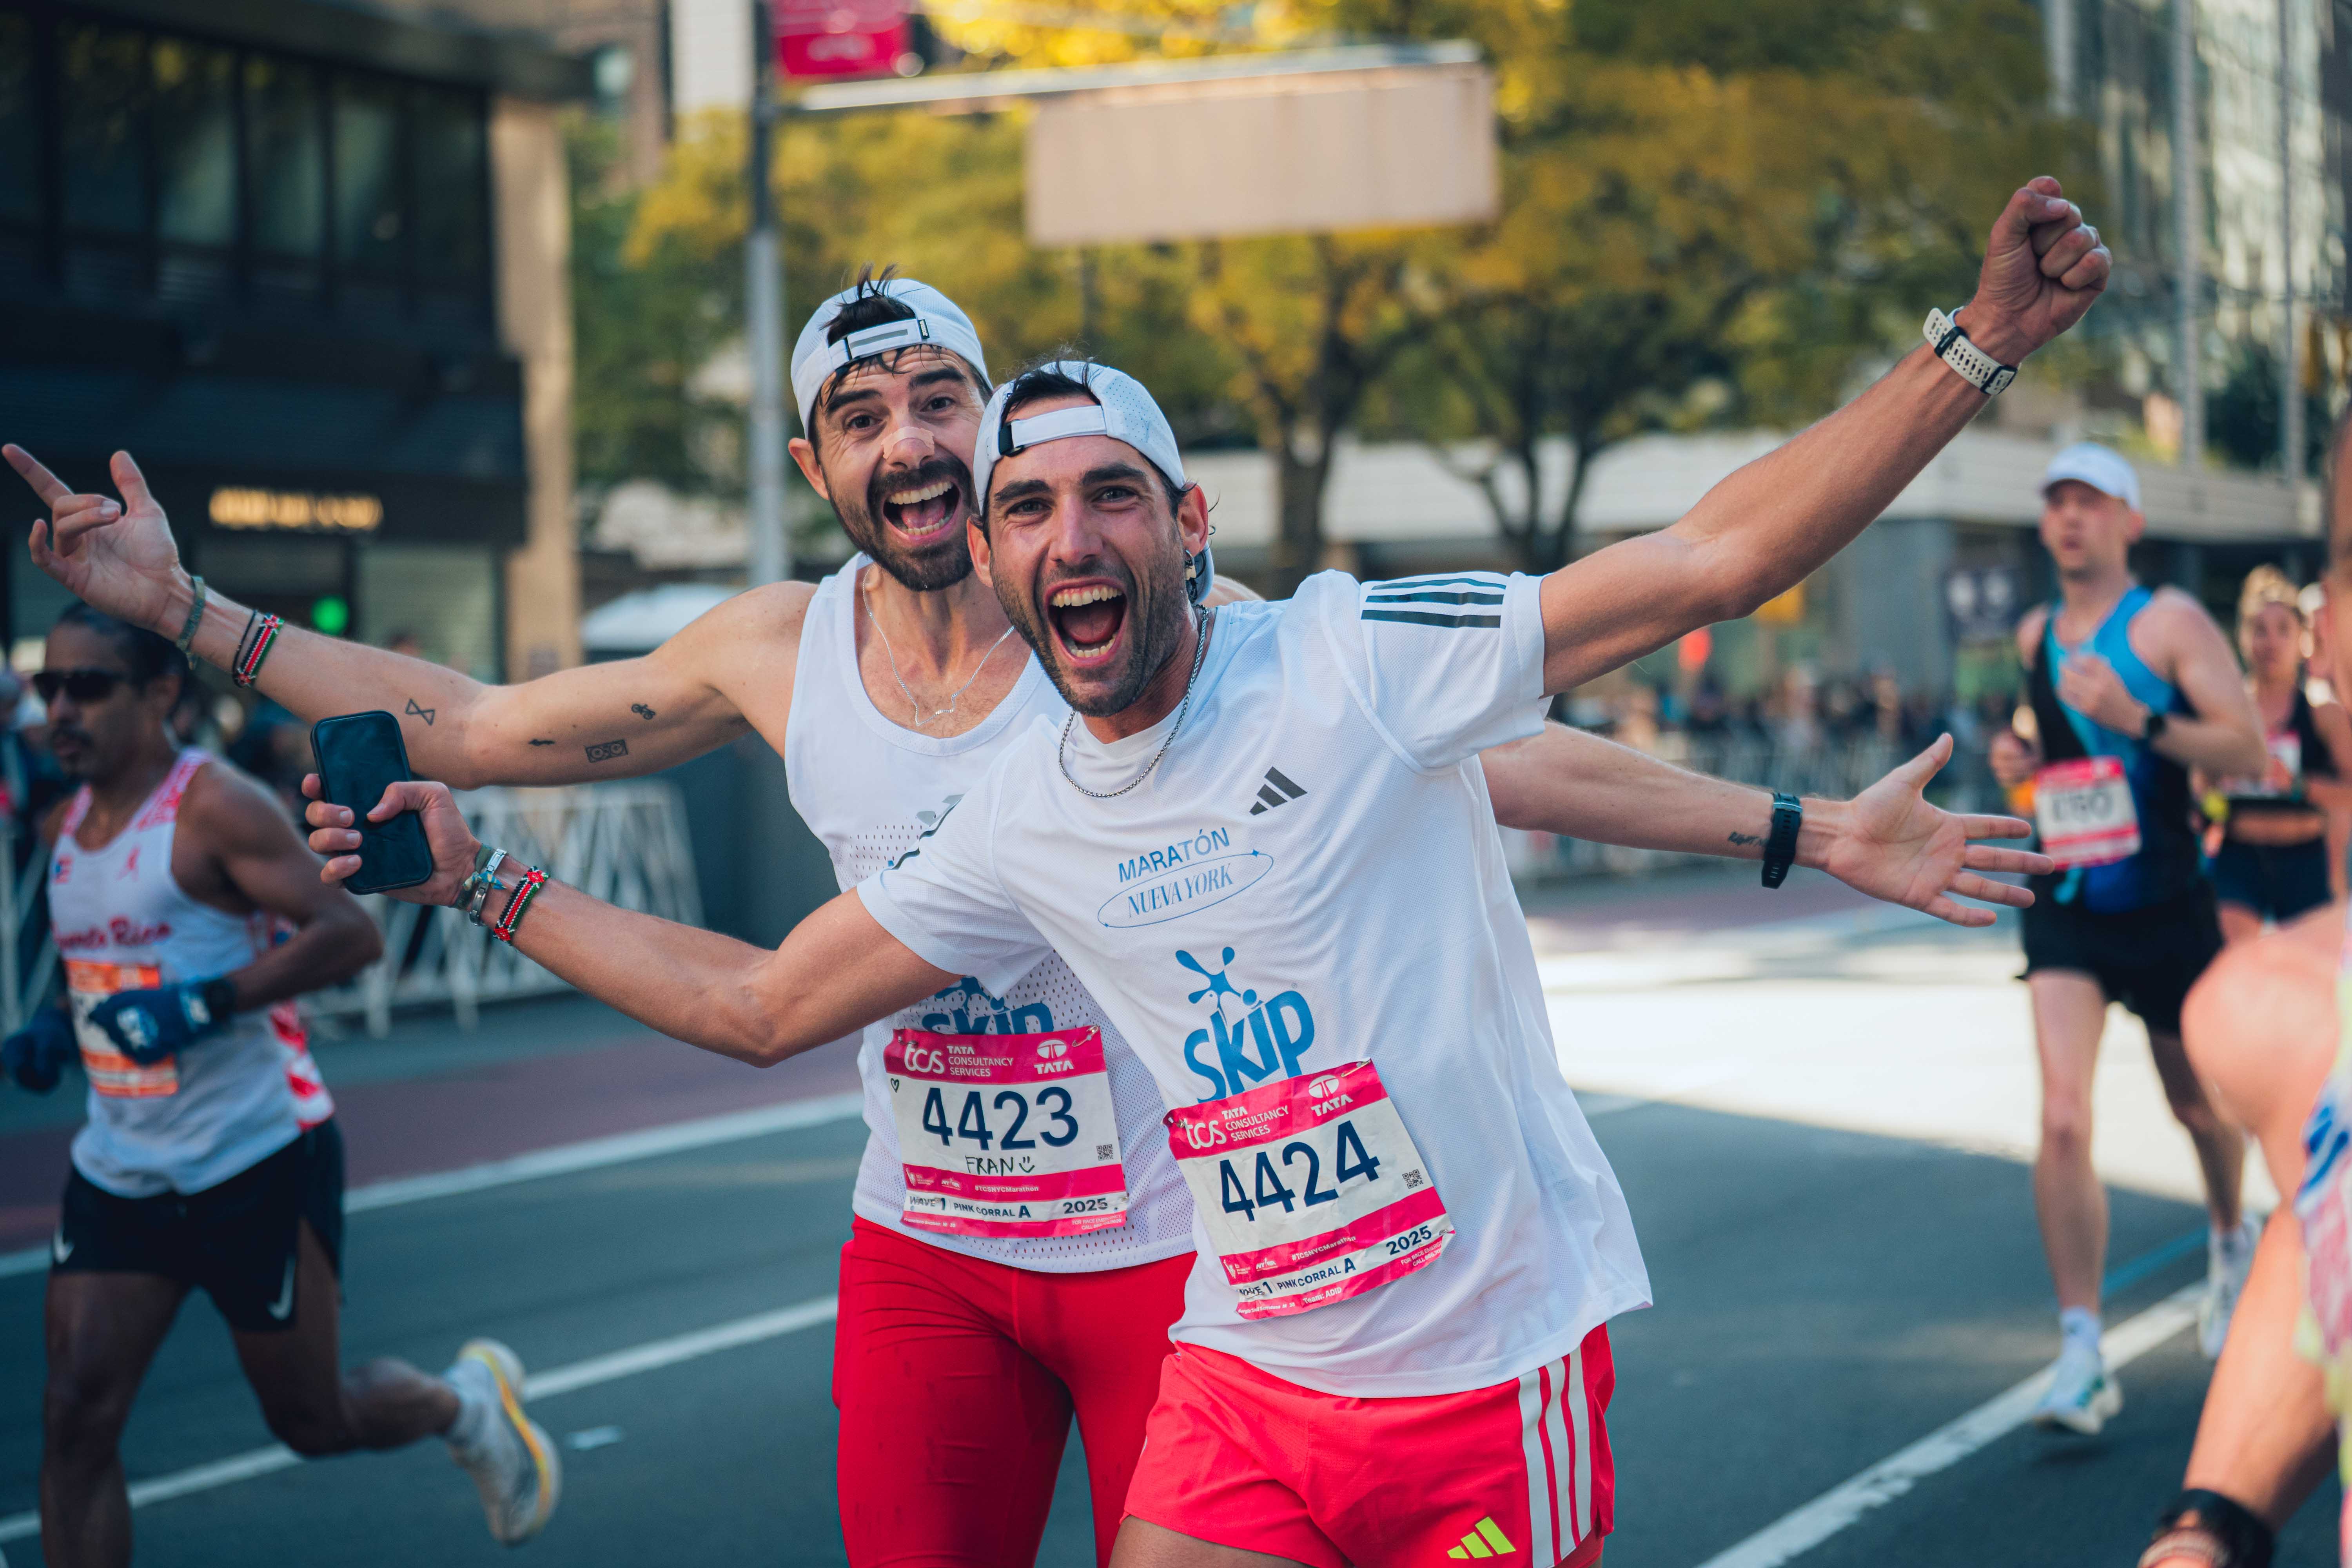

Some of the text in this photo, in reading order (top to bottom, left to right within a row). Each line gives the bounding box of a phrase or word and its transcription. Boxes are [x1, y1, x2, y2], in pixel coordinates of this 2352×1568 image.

[1118, 828, 1230, 883] MARATÓN
[1127, 863, 1234, 918] NUEVA YORK
[904, 1043, 944, 1074] tcs
[947, 1045, 975, 1054] TATA
[948, 1056, 1013, 1067] CONSULTANCY
[950, 1067, 991, 1077] SERVICES
[1034, 1060, 1074, 1074] TATA
[1222, 1106, 1248, 1120] TATA
[1311, 1094, 1353, 1117] TATA
[922, 1086, 1079, 1151] 4423
[1225, 1105, 1289, 1131] CONSULTANCY
[1184, 1118, 1226, 1149] tcs
[1231, 1124, 1270, 1142] SERVICES
[965, 1156, 1014, 1176] FRAN
[1219, 1120, 1380, 1222] 4424
[910, 1196, 1108, 1218] WAVE 1 PINK CORRAL A 2025
[1262, 1281, 1273, 1294] 1
[1277, 1279, 1298, 1290] PINK
[1298, 1265, 1341, 1286] CORRAL
[1344, 1258, 1356, 1274] A
[1386, 1225, 1432, 1255] 2025
[1292, 1236, 1356, 1261] #TCSNYCMarathon
[1411, 1252, 1424, 1260] RACE
[1303, 1294, 1325, 1304] Team:
[1325, 1287, 1343, 1298] ADID
